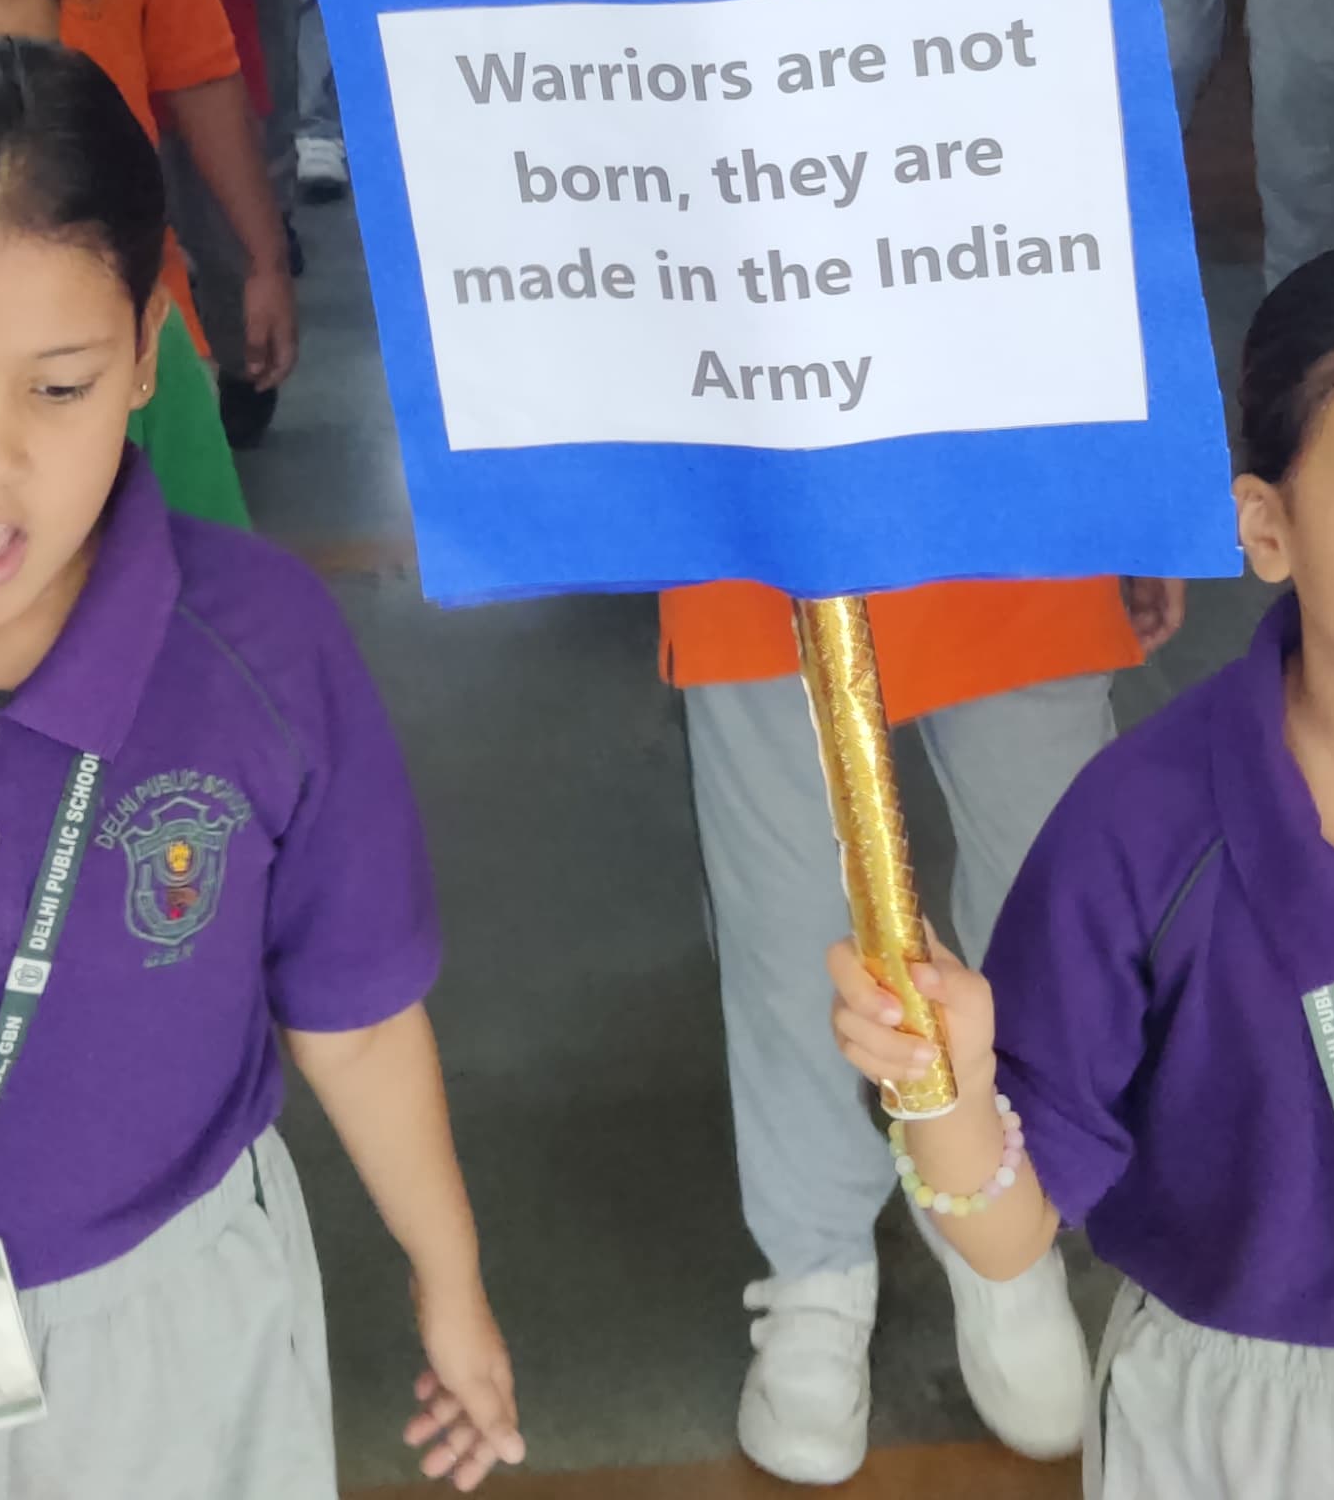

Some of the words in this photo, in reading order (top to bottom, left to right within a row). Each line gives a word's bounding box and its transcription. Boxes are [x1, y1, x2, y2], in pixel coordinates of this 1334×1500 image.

[455, 46, 753, 106] Warriors
[776, 41, 887, 95] are
[911, 19, 1037, 78] not
[514, 150, 691, 212] born,
[710, 147, 868, 209] they
[892, 134, 1004, 185] are
[453, 247, 635, 305] made
[654, 248, 718, 303] in
[738, 249, 852, 304] the
[875, 223, 1101, 289] Indian
[689, 349, 873, 412] Army
[95, 794, 140, 850] DELHI
[29, 891, 60, 951] DELHI
[46, 827, 80, 896] PUBLIC
